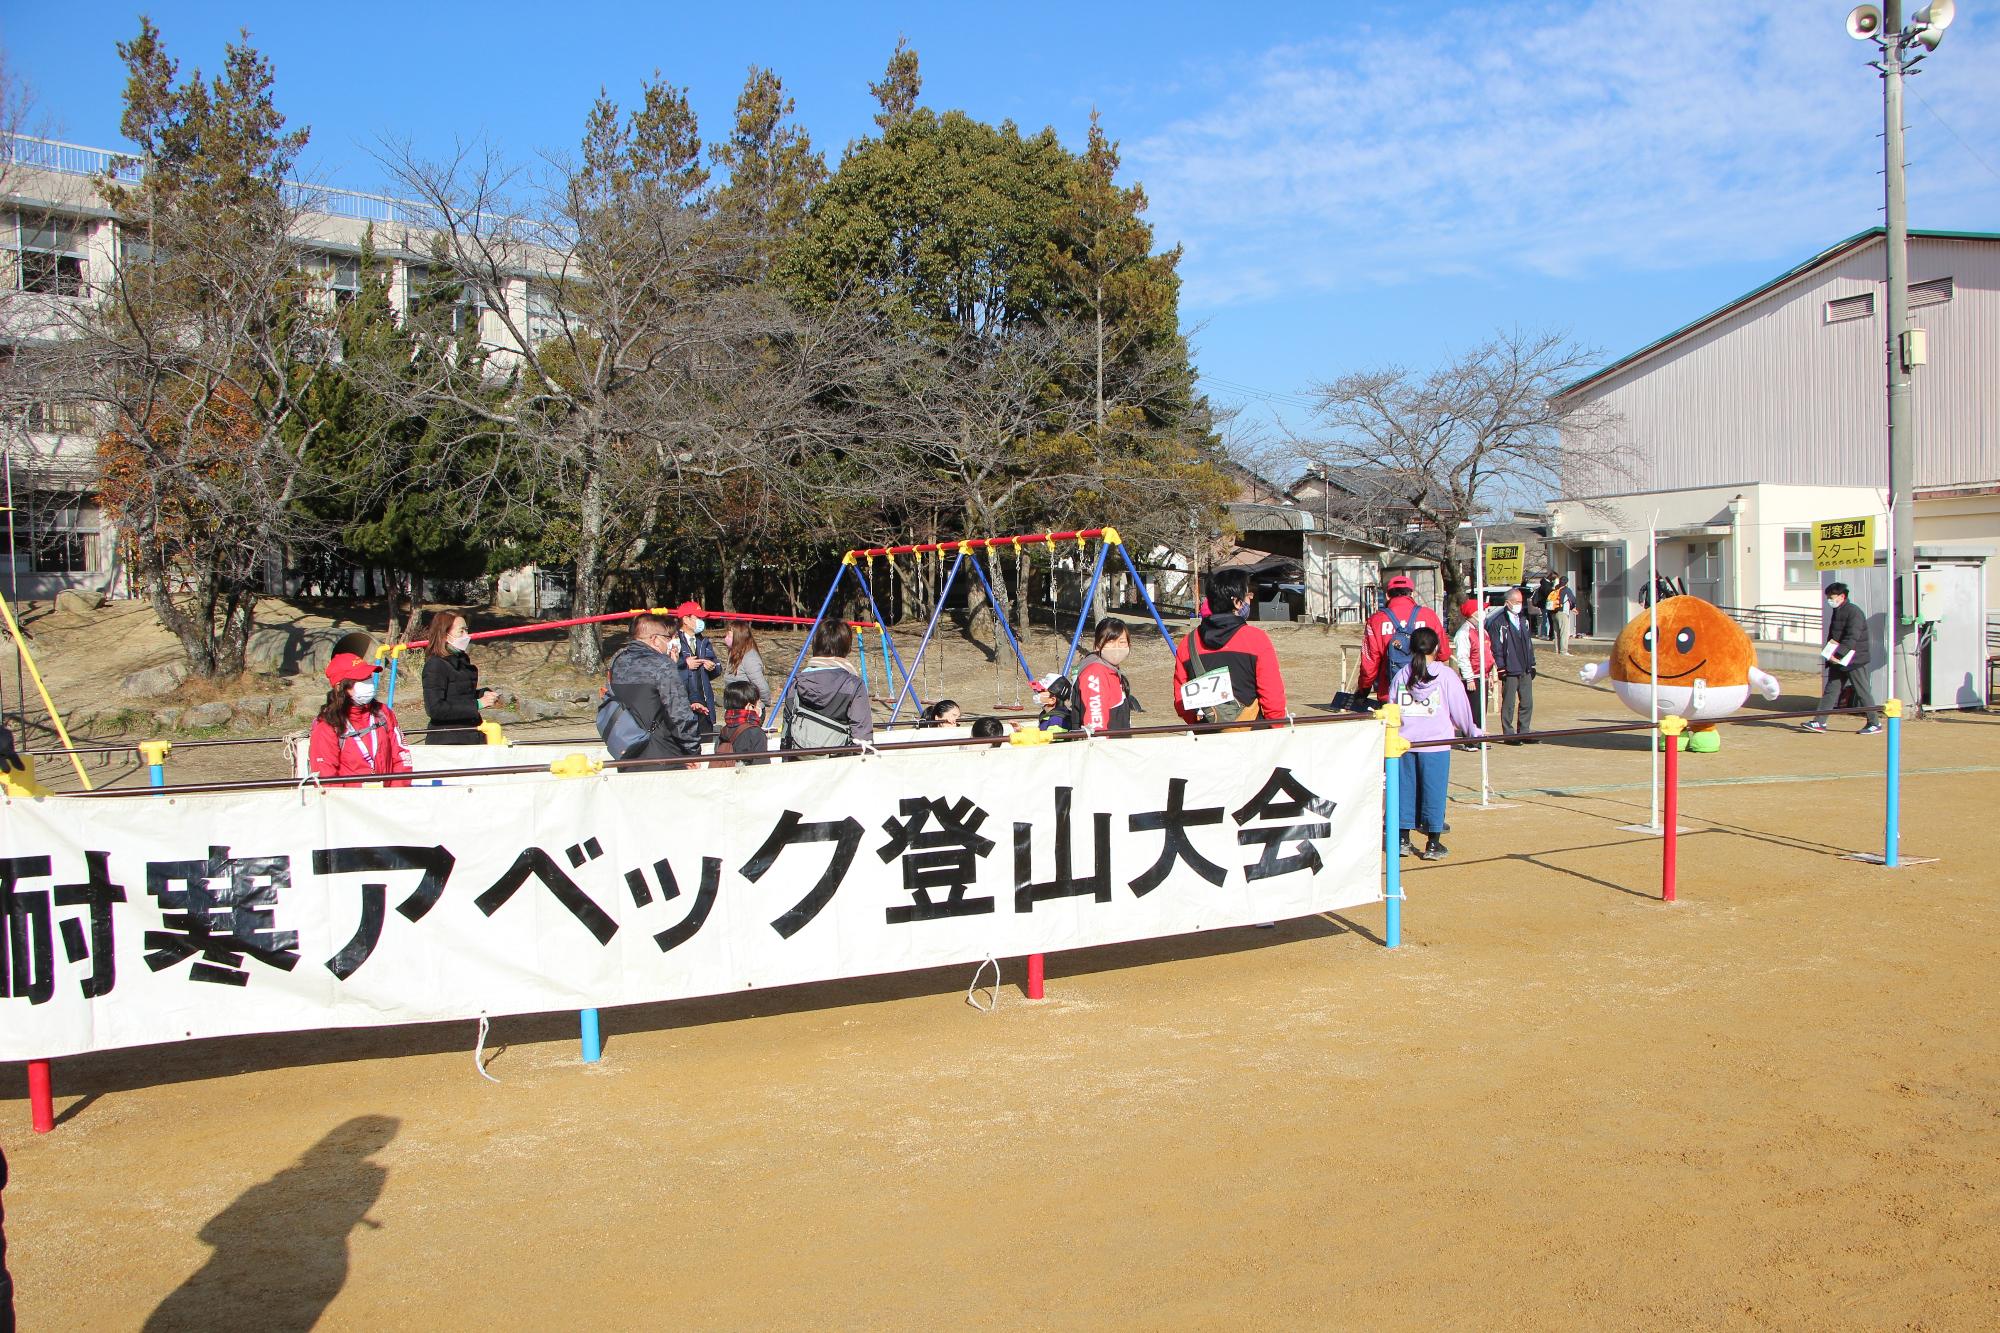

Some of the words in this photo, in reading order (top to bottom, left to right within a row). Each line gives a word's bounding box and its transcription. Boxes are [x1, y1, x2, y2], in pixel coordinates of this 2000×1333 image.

[1821, 522, 1865, 539] 耐寒登山
[1817, 541, 1867, 560] スタート
[1488, 561, 1518, 576] スタート
[1184, 675, 1221, 697] D-7
[0, 767, 1333, 1005] 耐寒アベック登山大会
